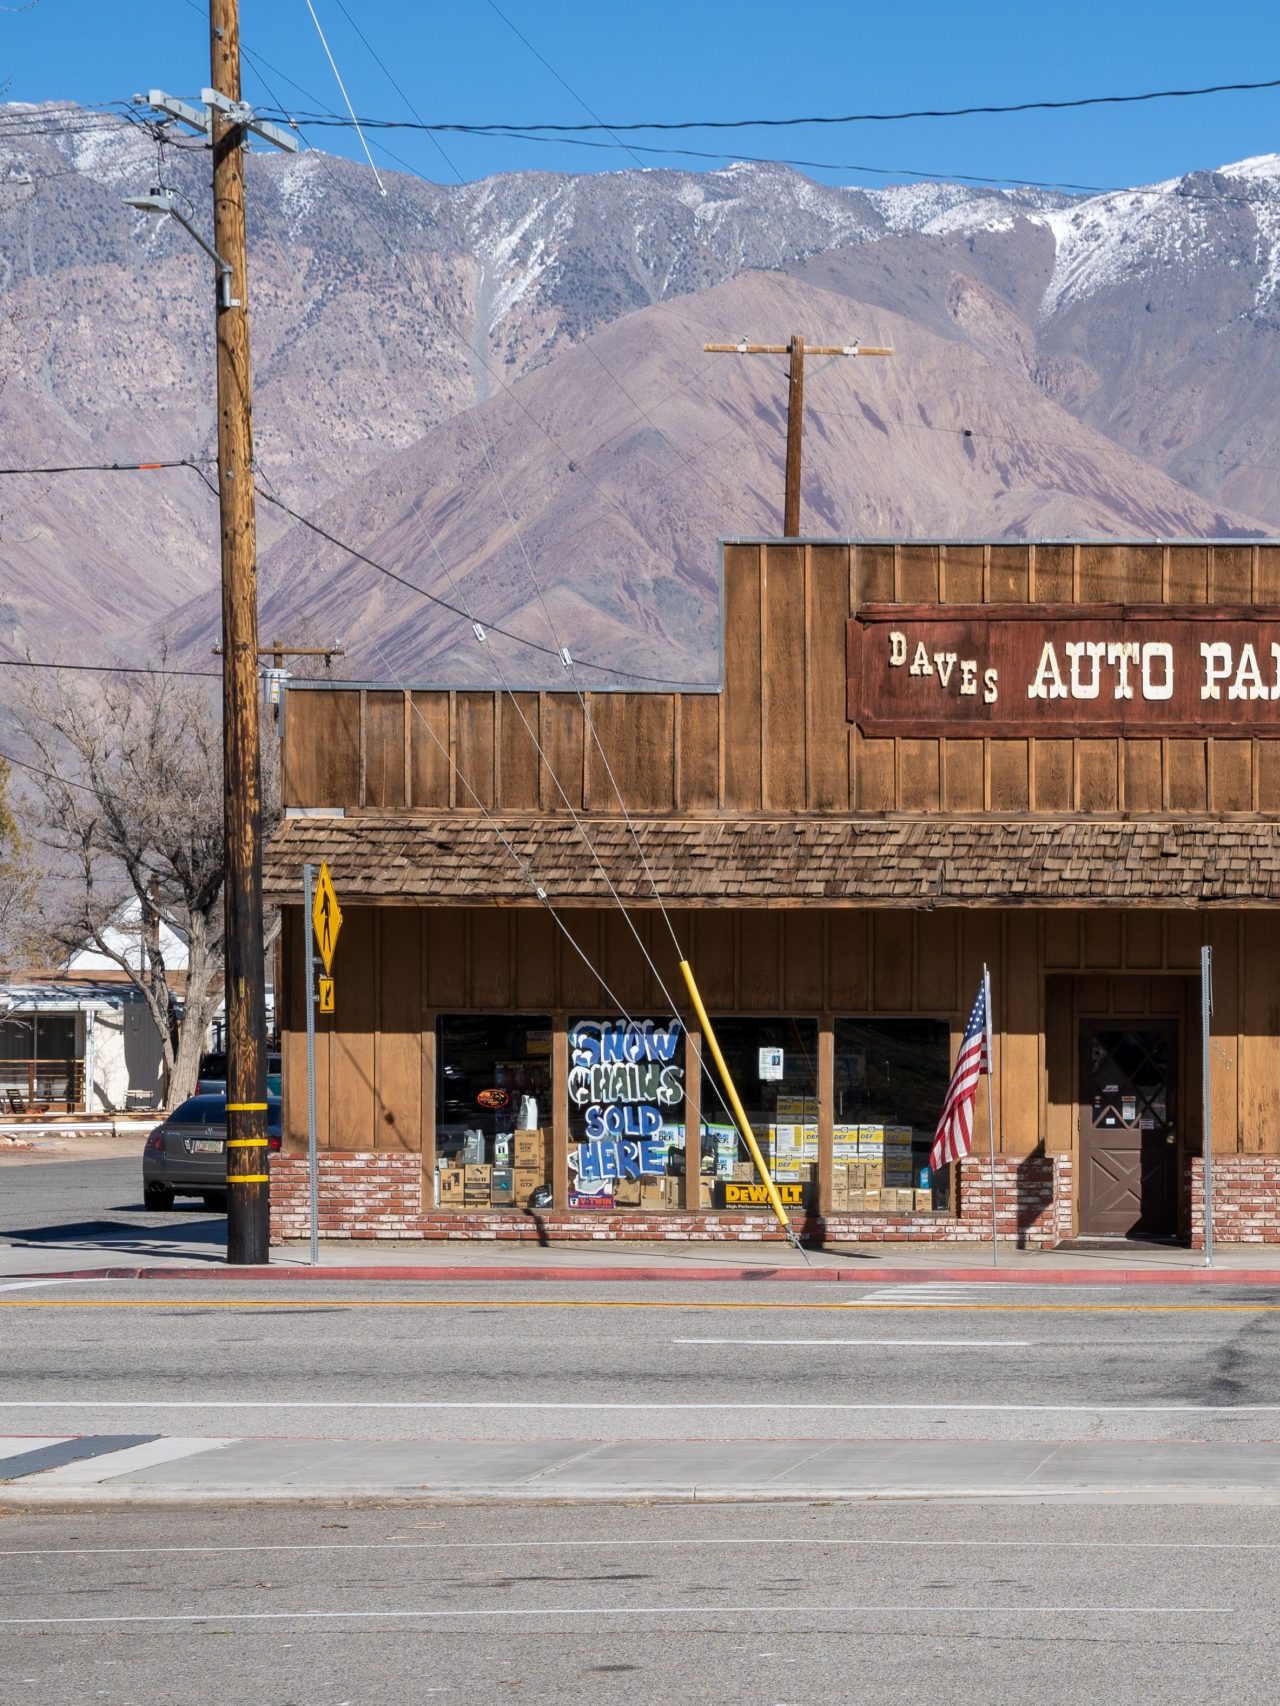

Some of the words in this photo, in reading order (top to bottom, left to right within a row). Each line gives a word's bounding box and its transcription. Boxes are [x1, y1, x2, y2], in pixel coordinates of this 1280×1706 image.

[889, 631, 999, 704] DAVES
[1027, 641, 1174, 701] AUTO
[568, 1018, 681, 1068] SNOW
[568, 1062, 684, 1111] CHAINS
[585, 1105, 663, 1139] SOLD
[578, 1139, 666, 1181] HERE
[579, 1197, 612, 1206] V-TWIN
